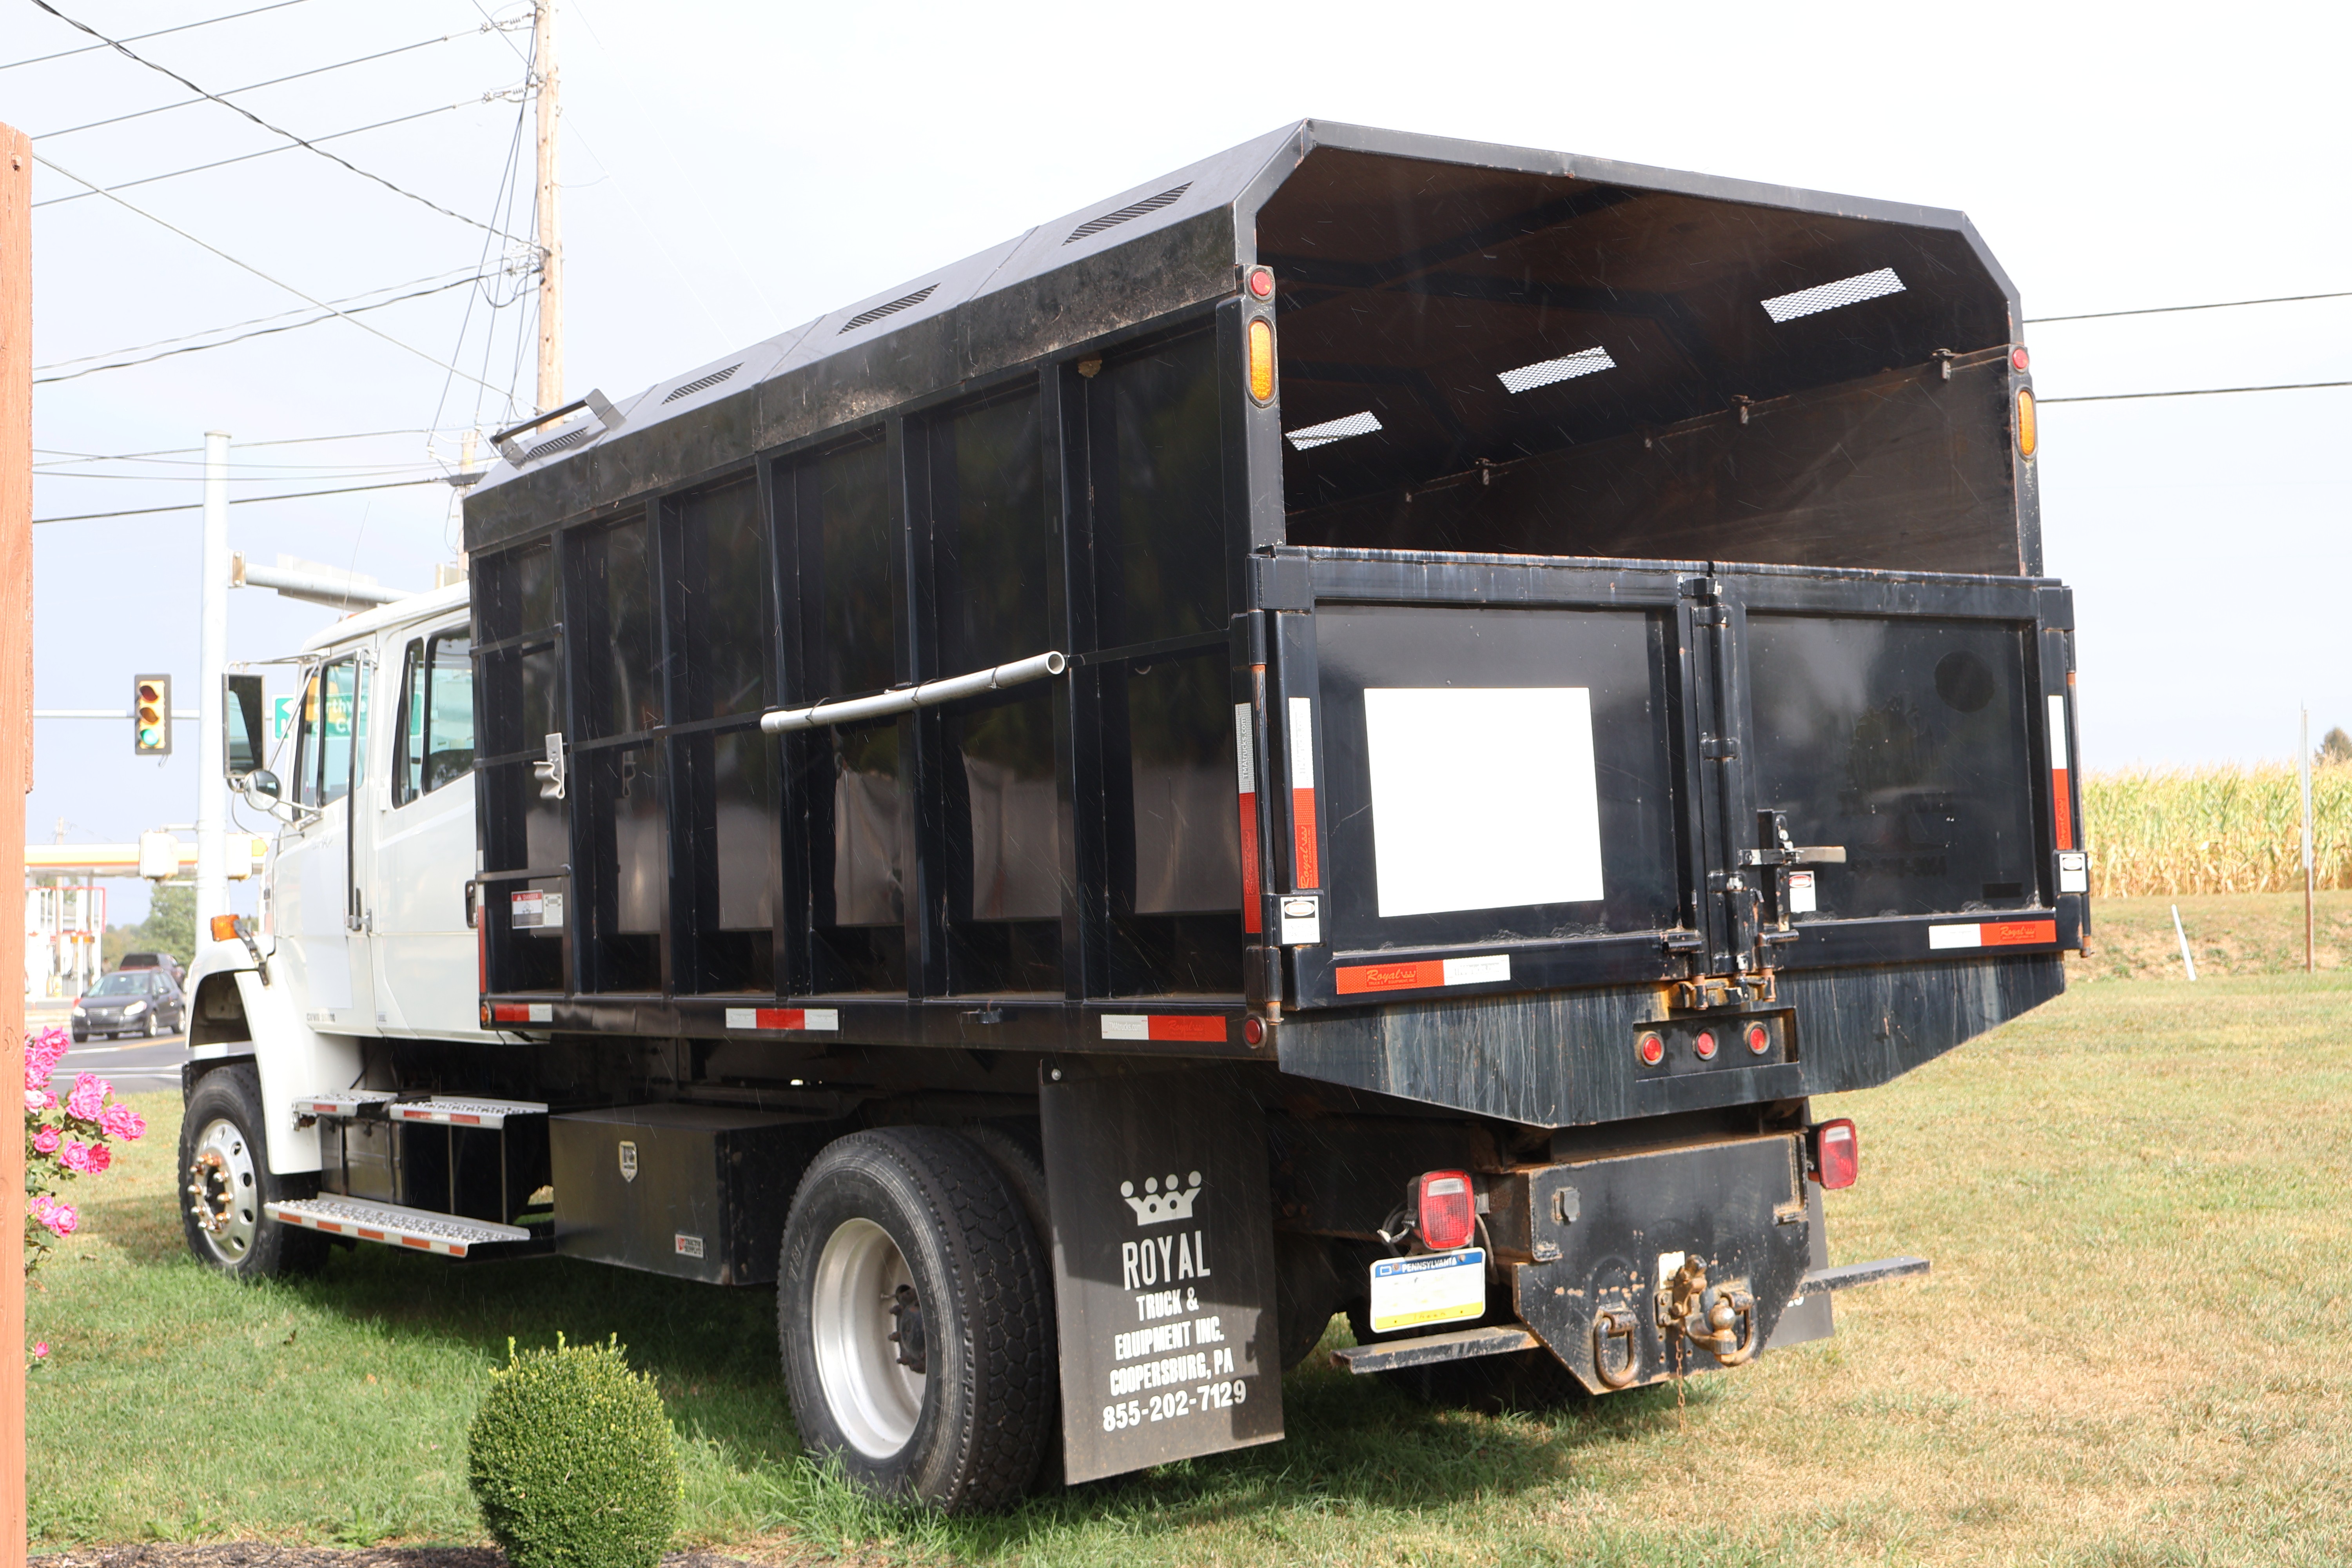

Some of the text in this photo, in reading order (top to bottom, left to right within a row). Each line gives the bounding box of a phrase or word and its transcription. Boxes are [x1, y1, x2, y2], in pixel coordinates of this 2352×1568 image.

[1299, 846, 1311, 888] Royal
[1367, 968, 1401, 983] Royal
[1122, 1230, 1210, 1290] ROYAL
[1402, 1256, 1457, 1273] PENNSYLVANIA
[1136, 1287, 1199, 1321] TRUCK &
[1115, 1316, 1225, 1361] EQUIPMENT INC.
[1110, 1347, 1234, 1396] COOPERSBURG, PA
[1103, 1379, 1247, 1432] 855-202-7129
